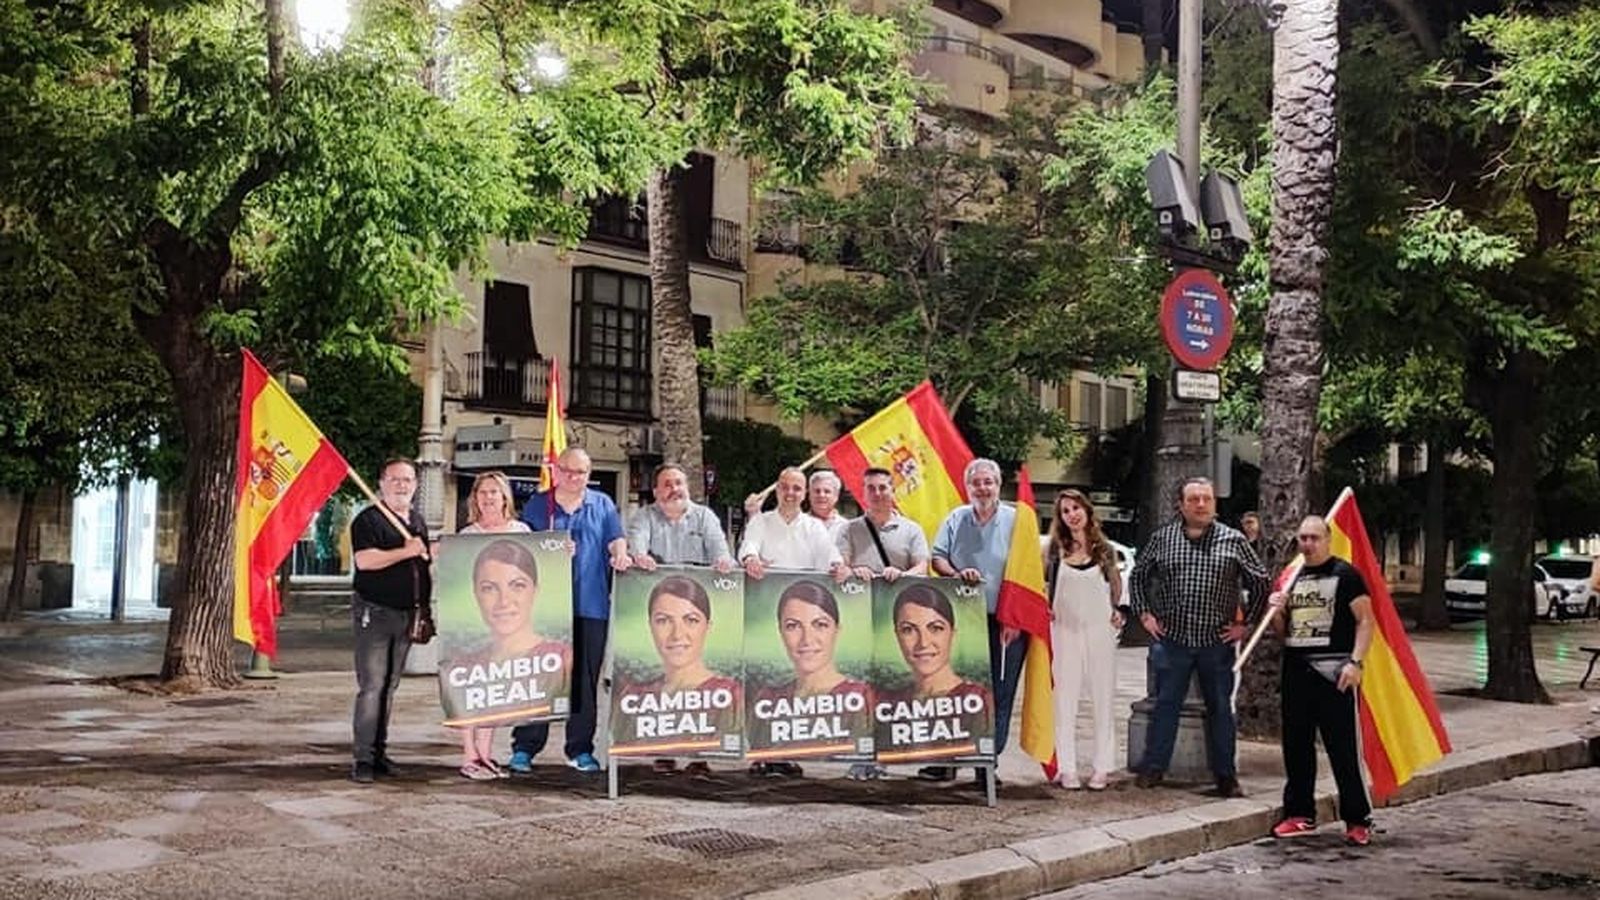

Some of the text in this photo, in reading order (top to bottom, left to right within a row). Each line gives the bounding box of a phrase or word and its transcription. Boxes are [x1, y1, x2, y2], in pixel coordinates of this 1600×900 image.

[539, 539, 565, 551] VOX
[713, 577, 737, 591] VOX
[840, 582, 865, 594] VOX
[955, 585, 980, 597] VOX
[448, 653, 562, 687] CAMBIO
[465, 679, 546, 710] REAL
[620, 688, 733, 714] CAMBIO
[755, 691, 865, 719] CAMBIO
[875, 693, 984, 722] CAMBIO
[636, 713, 716, 738] REAL
[770, 716, 850, 742] REAL
[891, 719, 970, 745] REAL
